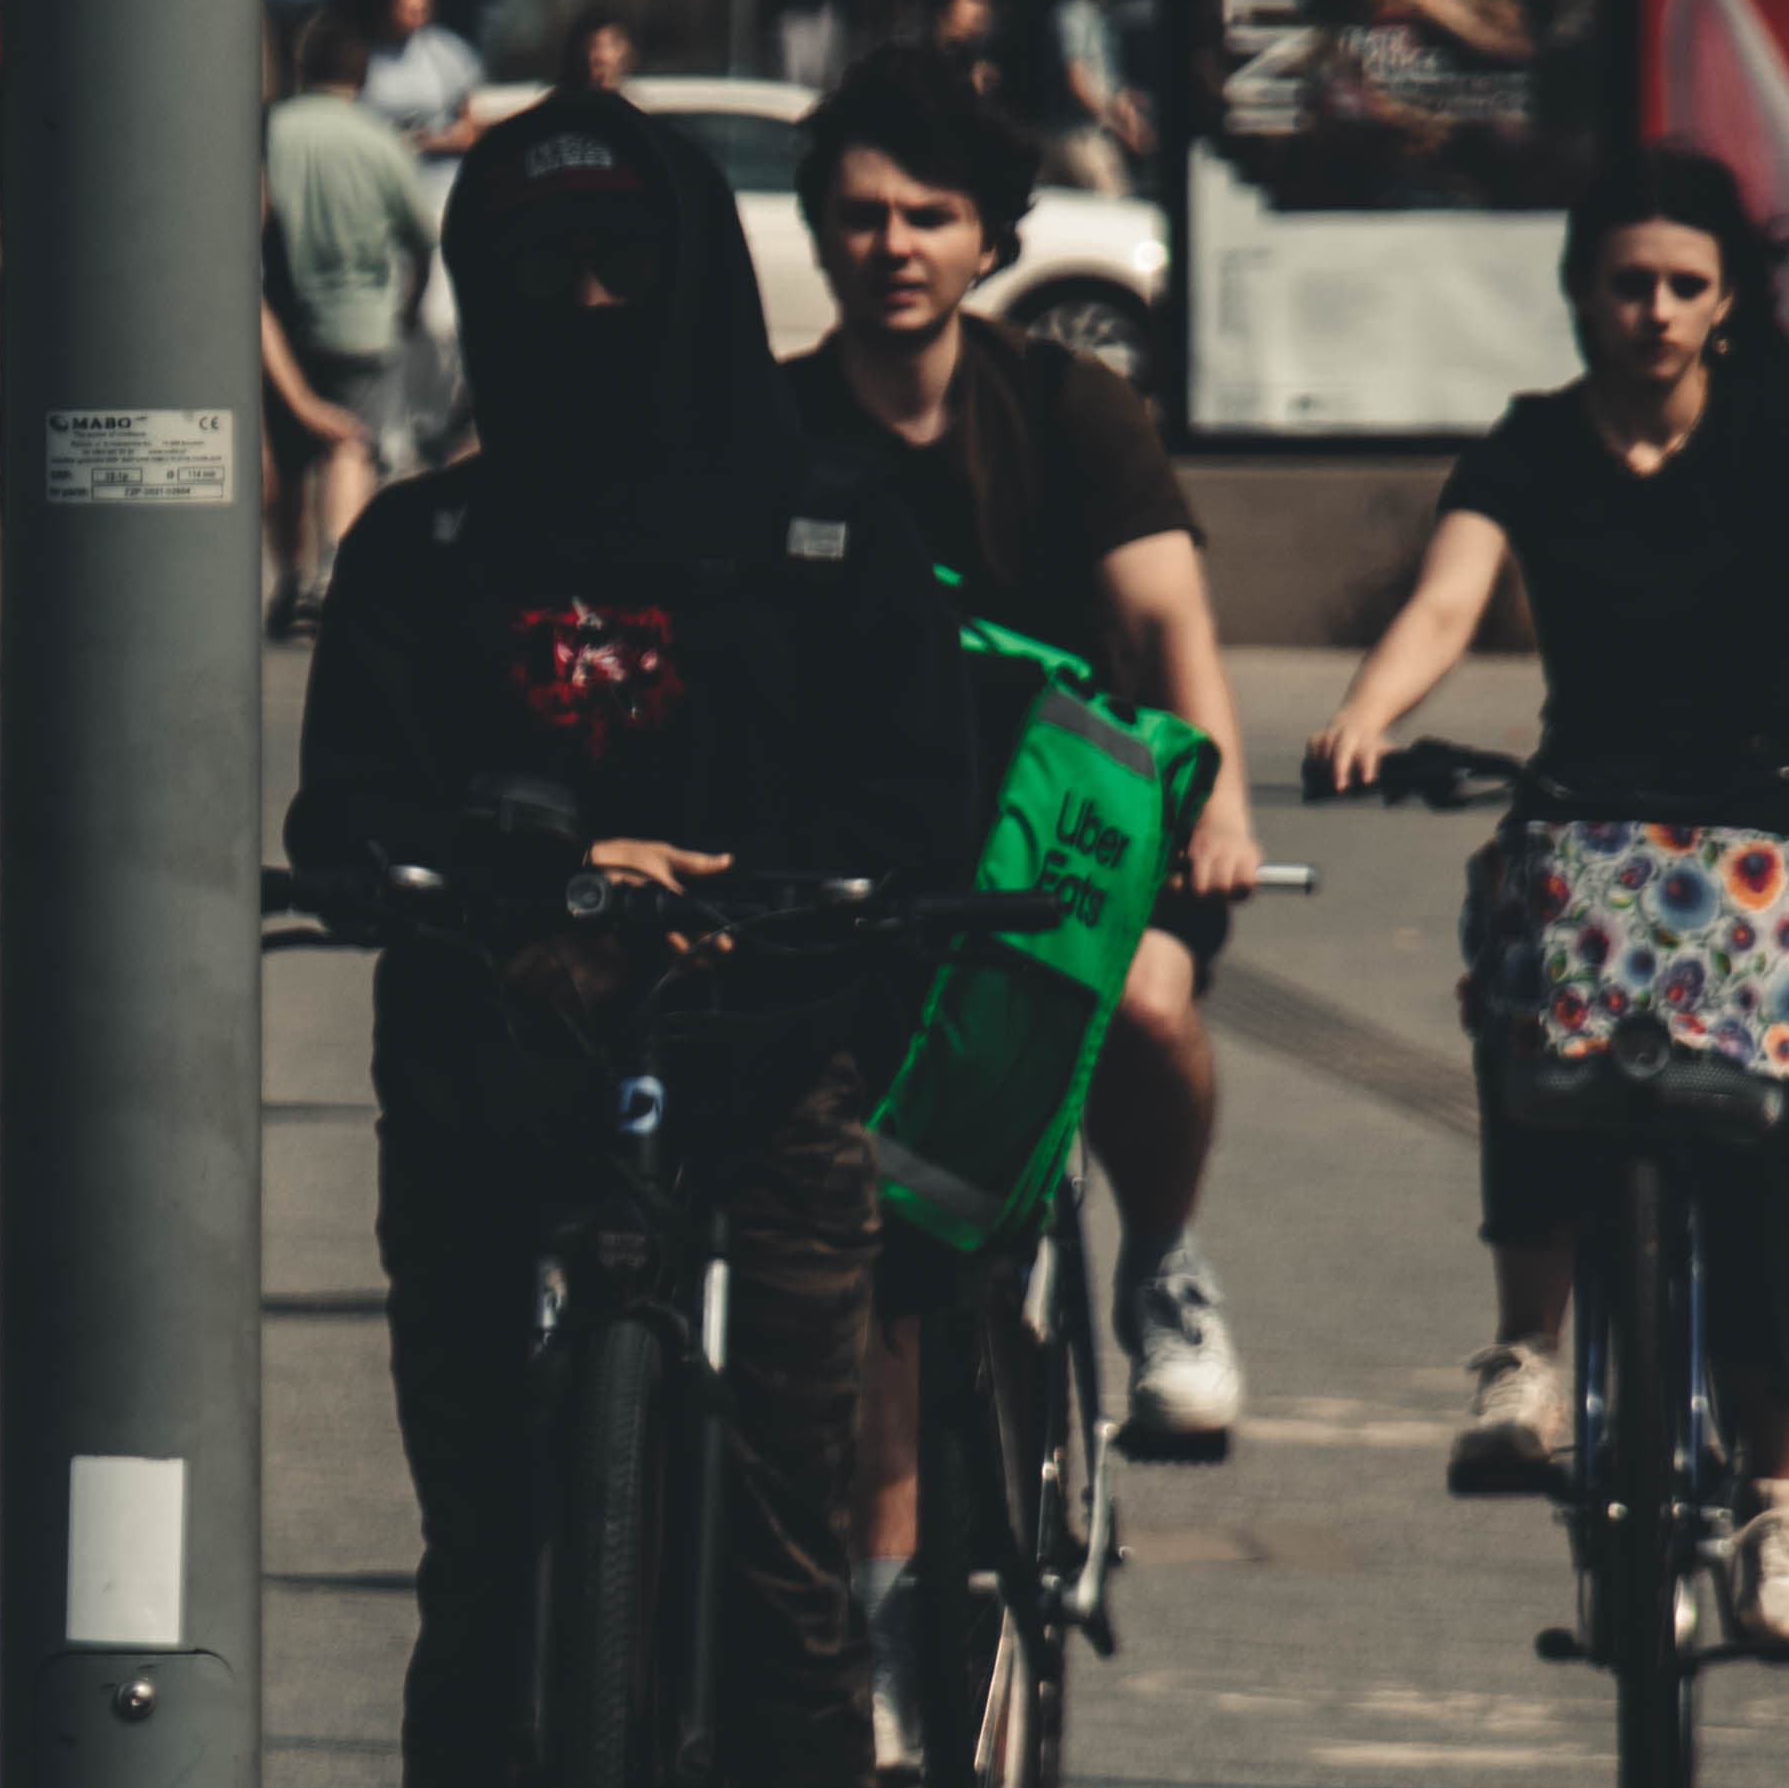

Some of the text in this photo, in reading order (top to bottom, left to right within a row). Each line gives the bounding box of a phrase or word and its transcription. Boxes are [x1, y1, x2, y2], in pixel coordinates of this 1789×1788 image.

[72, 416, 131, 430] MABO
[1057, 789, 1129, 868] Uber
[1039, 850, 1107, 927] Eats
